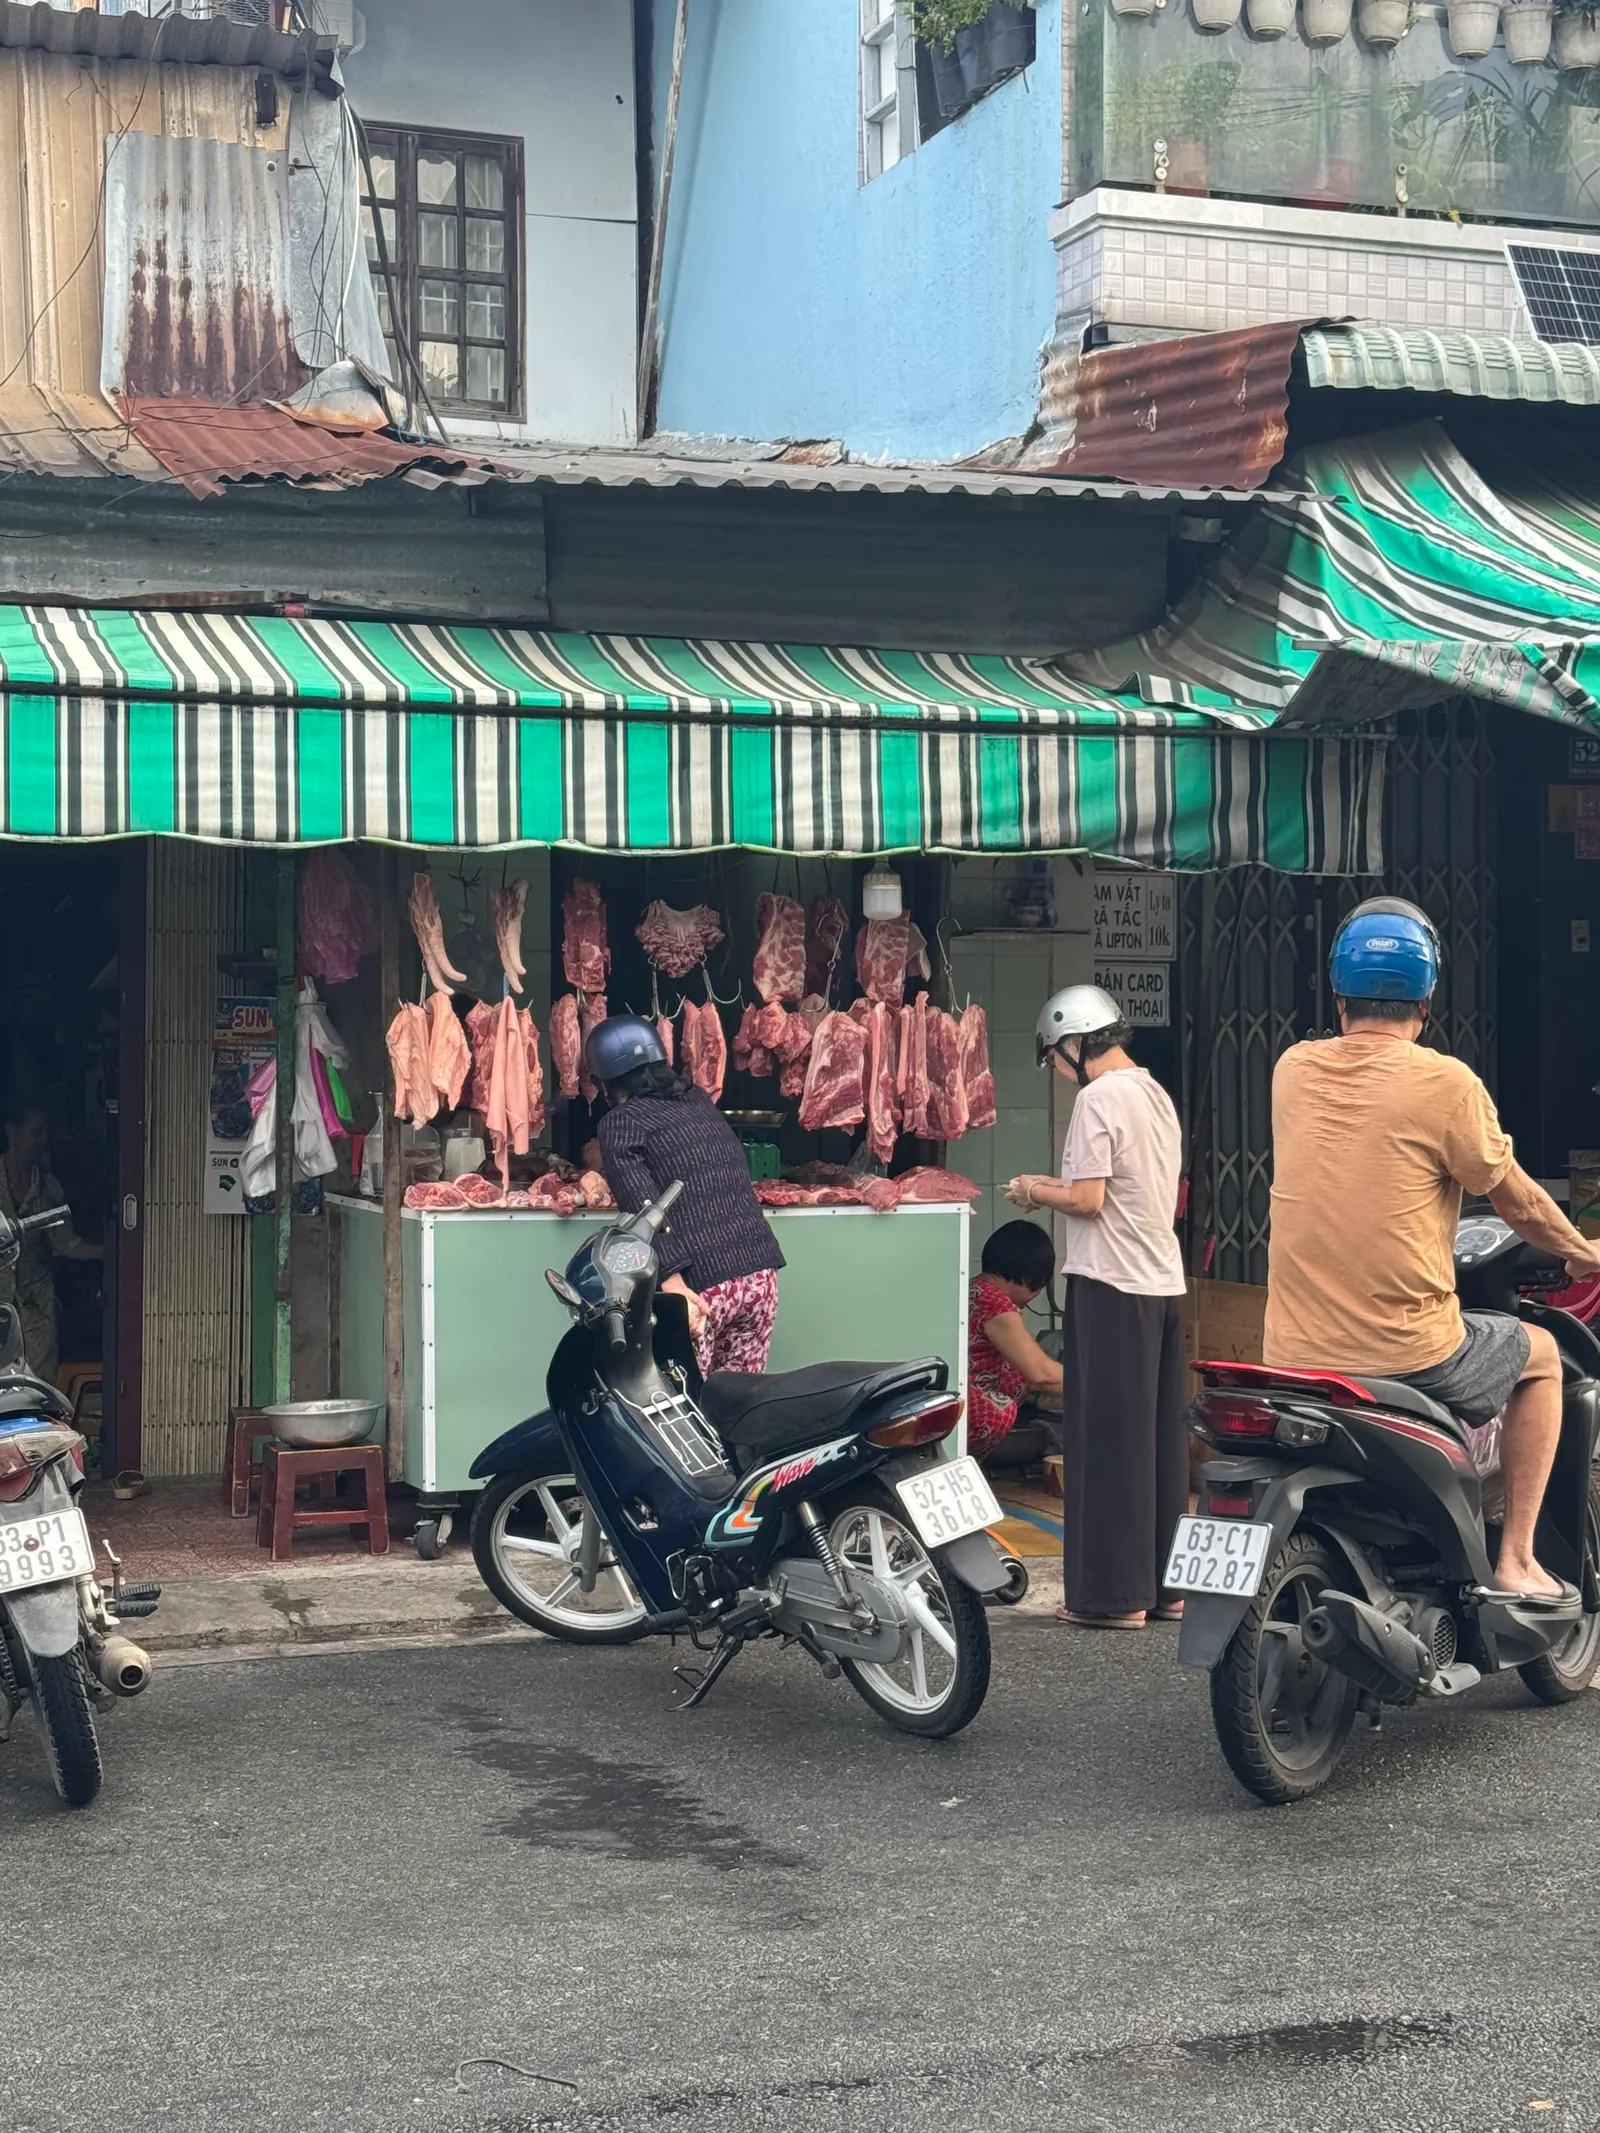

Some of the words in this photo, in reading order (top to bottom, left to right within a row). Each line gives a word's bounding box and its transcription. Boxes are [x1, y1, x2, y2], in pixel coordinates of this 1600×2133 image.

[1575, 741, 1600, 762] 52
[1116, 877, 1141, 901] VẮT
[1114, 902, 1141, 926] TẮC
[1150, 890, 1159, 915] Ly
[1162, 892, 1171, 911] to
[1106, 932, 1142, 948] LIPTON
[1149, 926, 1170, 946] 10k
[1094, 967, 1123, 992] BÁN
[1128, 973, 1163, 992] CARD
[233, 1006, 269, 1030] SUN
[1128, 999, 1163, 1022] THOẠI
[211, 1157, 229, 1168] SUN
[773, 1457, 819, 1493] Wave
[911, 1466, 974, 1510] 52-H5
[927, 1494, 989, 1538] 3648
[1187, 1522, 1253, 1557] 63-C1
[0, 1545, 76, 1585] 9993
[1169, 1553, 1256, 1591] 502.87
